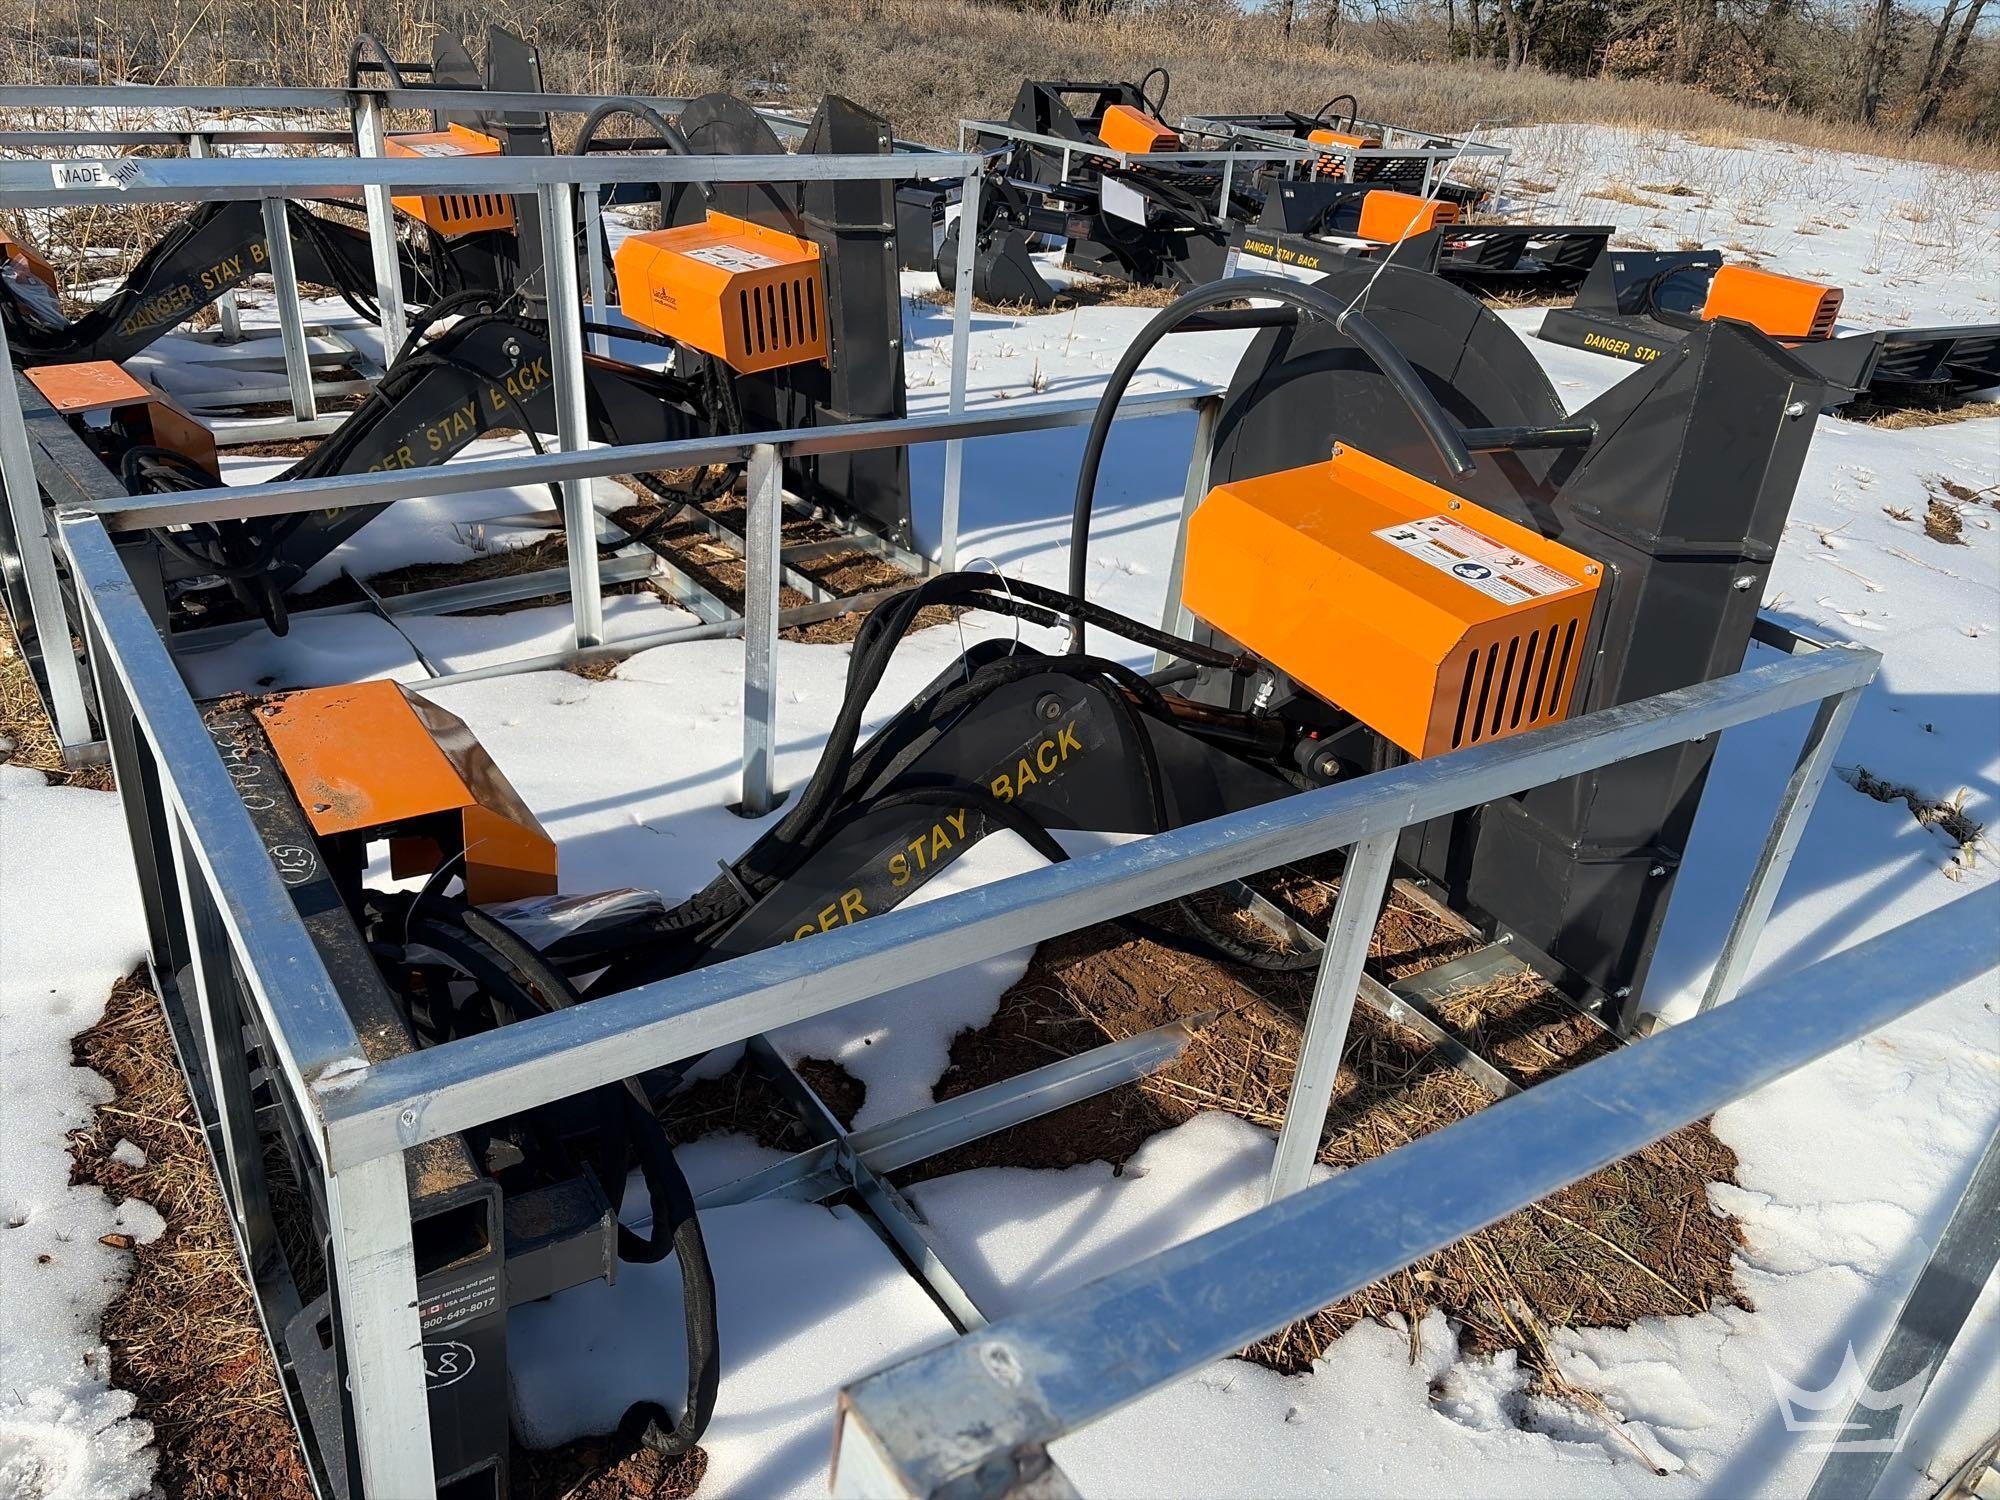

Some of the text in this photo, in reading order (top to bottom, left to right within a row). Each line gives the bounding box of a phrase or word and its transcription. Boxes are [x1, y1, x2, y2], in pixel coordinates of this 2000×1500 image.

[59, 168, 102, 184] MADE
[1244, 239, 1320, 269] DANGER STAY BACK
[124, 254, 241, 336] DANGER STAY
[1584, 332, 1661, 361] DANGER STA
[426, 356, 550, 452] STAY BACK
[888, 808, 970, 888] STAY
[990, 720, 1083, 804] BACK
[442, 1286, 465, 1298] service
[466, 1281, 478, 1289] and
[479, 1275, 496, 1286] parts
[444, 1286, 496, 1308] USA and Canada
[420, 1297, 496, 1329] -800-649-8017
